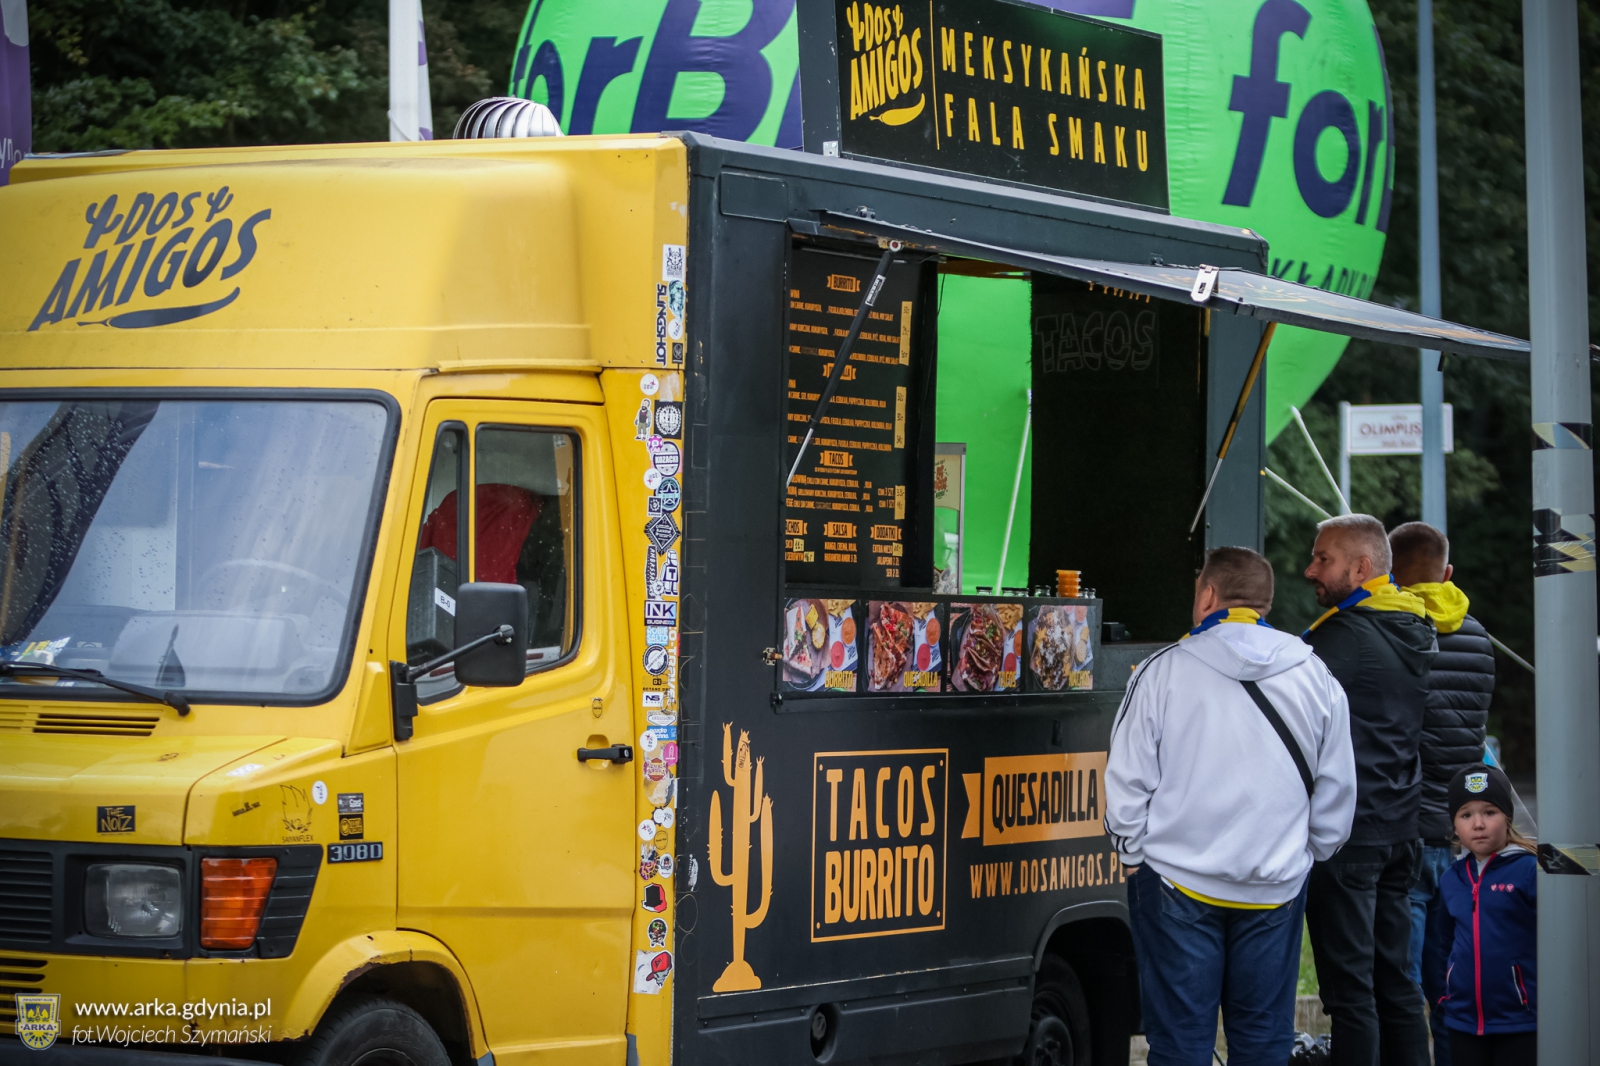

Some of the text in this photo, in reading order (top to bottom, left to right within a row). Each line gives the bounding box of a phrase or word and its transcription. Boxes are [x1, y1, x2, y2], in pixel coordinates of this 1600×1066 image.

[864, 3, 892, 51] DOS
[851, 27, 923, 120] AMIGOS
[941, 27, 1146, 110] MEKSYKAŃSKA
[945, 93, 1148, 171] FALA SMAKU
[114, 192, 202, 245] DOS
[27, 208, 272, 332] AMIGOS
[833, 276, 854, 290] BURRITO
[657, 283, 667, 367] SLINGSHOT
[1035, 310, 1155, 373] TACOS
[828, 452, 844, 465] TACOS
[832, 523, 848, 537] SALSA
[876, 526, 896, 539] DODATKI
[647, 603, 674, 617] INK
[824, 671, 854, 689] BURRITO
[903, 671, 938, 688] QUESADILLA
[998, 671, 1017, 688] TACOS
[825, 765, 936, 842] TACOS
[991, 769, 1100, 834] QUESADILLA
[330, 843, 383, 862] 308D
[970, 852, 1126, 899] WWW.DOSAMIGOS.PL
[824, 844, 935, 924] BURRITO
